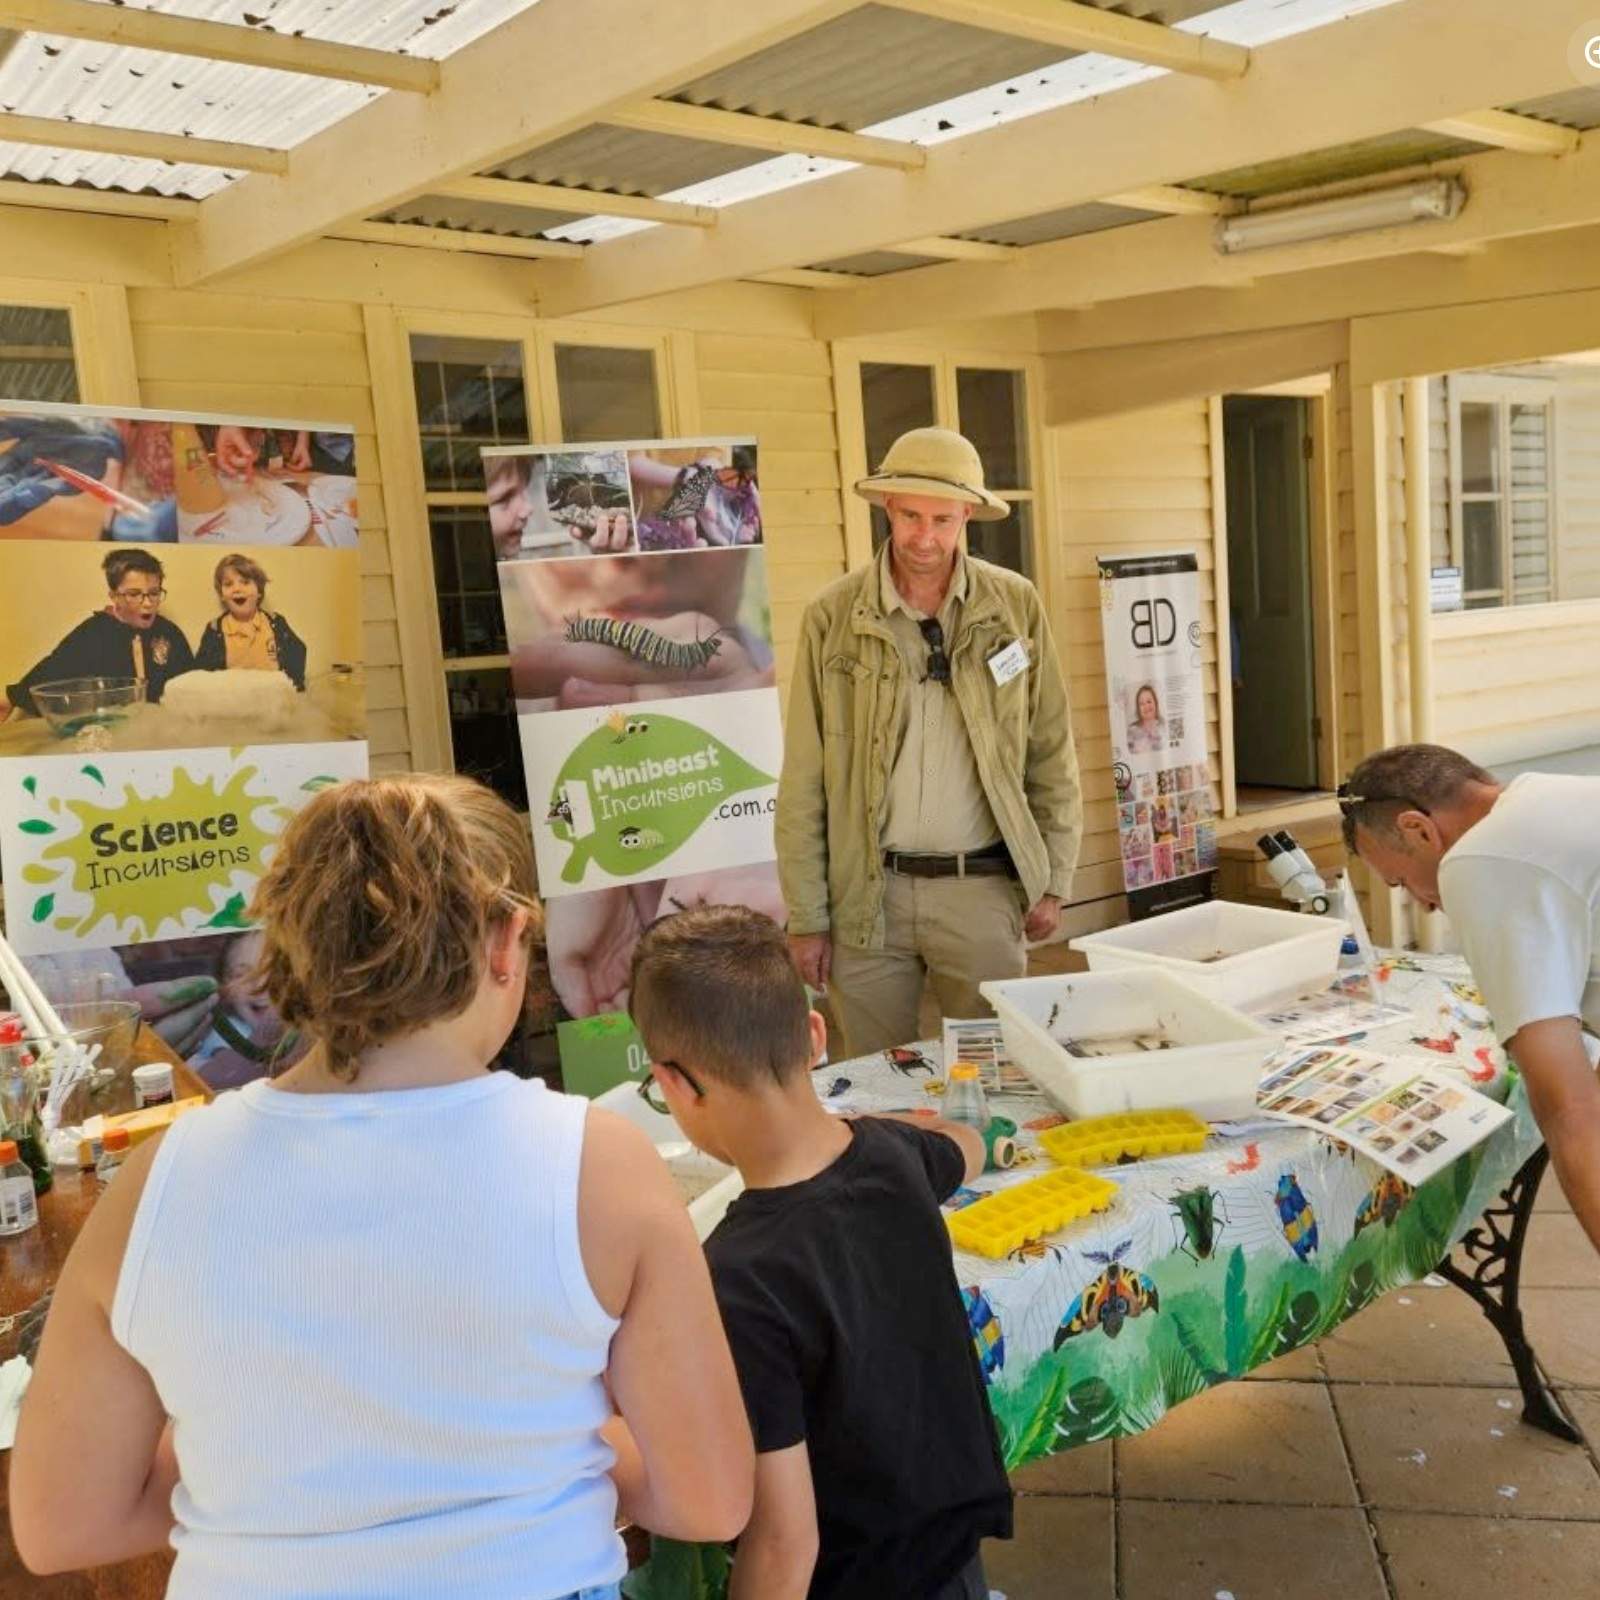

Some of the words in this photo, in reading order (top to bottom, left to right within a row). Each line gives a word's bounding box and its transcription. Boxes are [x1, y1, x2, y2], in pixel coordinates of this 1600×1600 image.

[592, 744, 720, 793] Minibeast
[599, 776, 724, 821] Incursions
[90, 812, 239, 858] Science
[86, 846, 251, 890] Incursions
